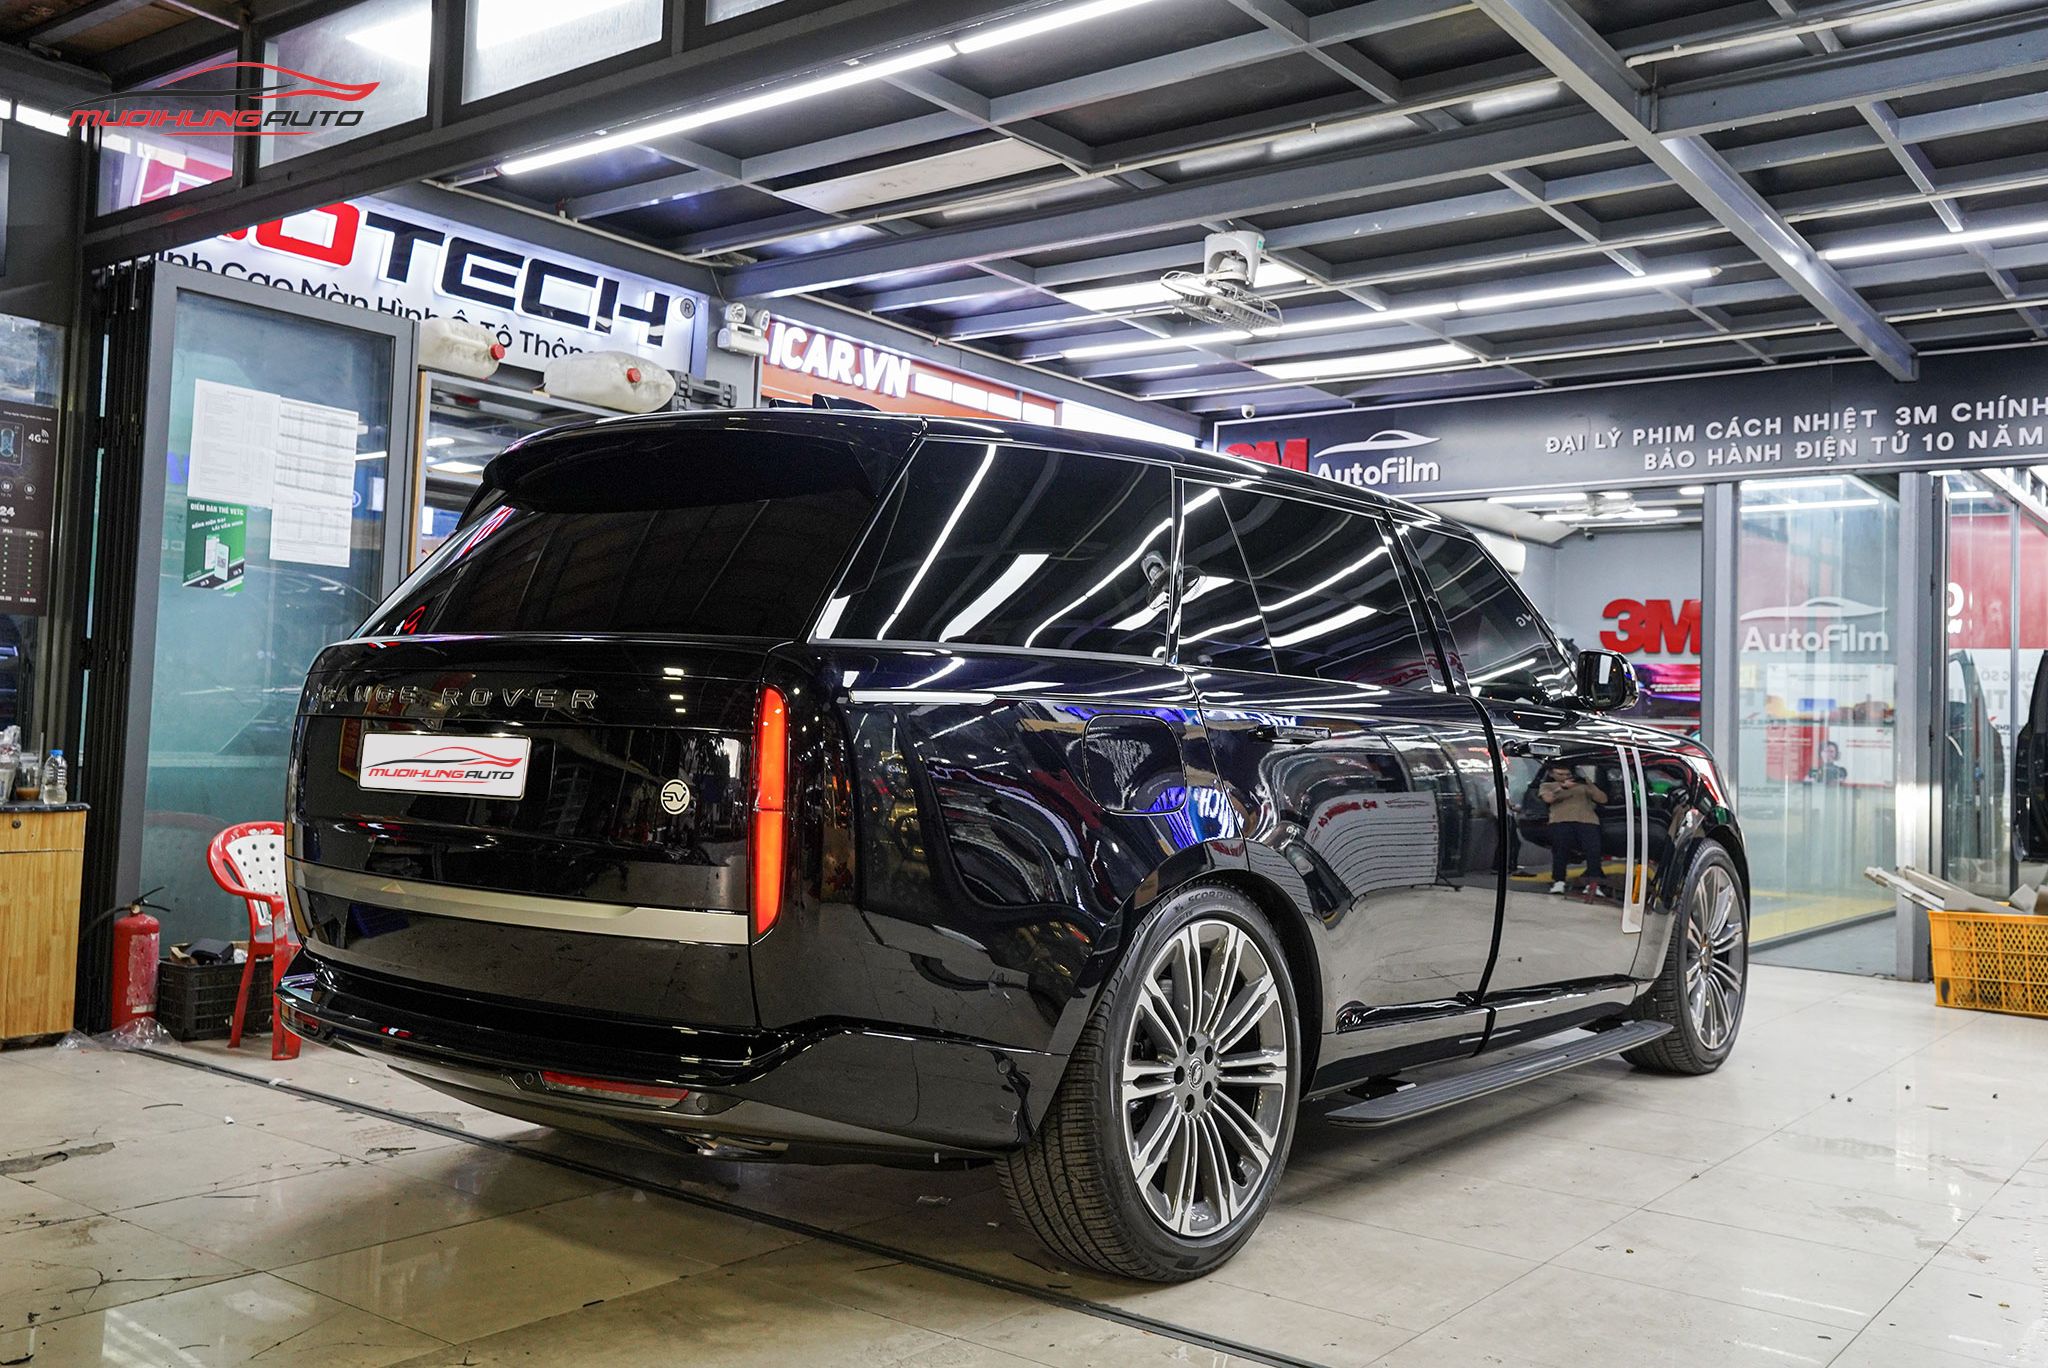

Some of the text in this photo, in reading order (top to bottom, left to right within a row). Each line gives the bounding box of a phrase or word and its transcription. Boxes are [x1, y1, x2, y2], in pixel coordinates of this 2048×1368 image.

[519, 330, 595, 358] Thô
[763, 323, 911, 399] ICAR.VN
[1545, 394, 2048, 455] ĐẠI LÝ PHIM CÁCH NHIỆT 3M CHÍNH
[1644, 423, 2043, 470] BẢO HÀNH ĐIỆN TỬ 10 NĂM
[1317, 456, 1440, 486] AutoFilm
[1599, 598, 1702, 655] 3M
[1740, 623, 1889, 653] AutoFilm
[320, 685, 599, 710] RANGE ROVER
